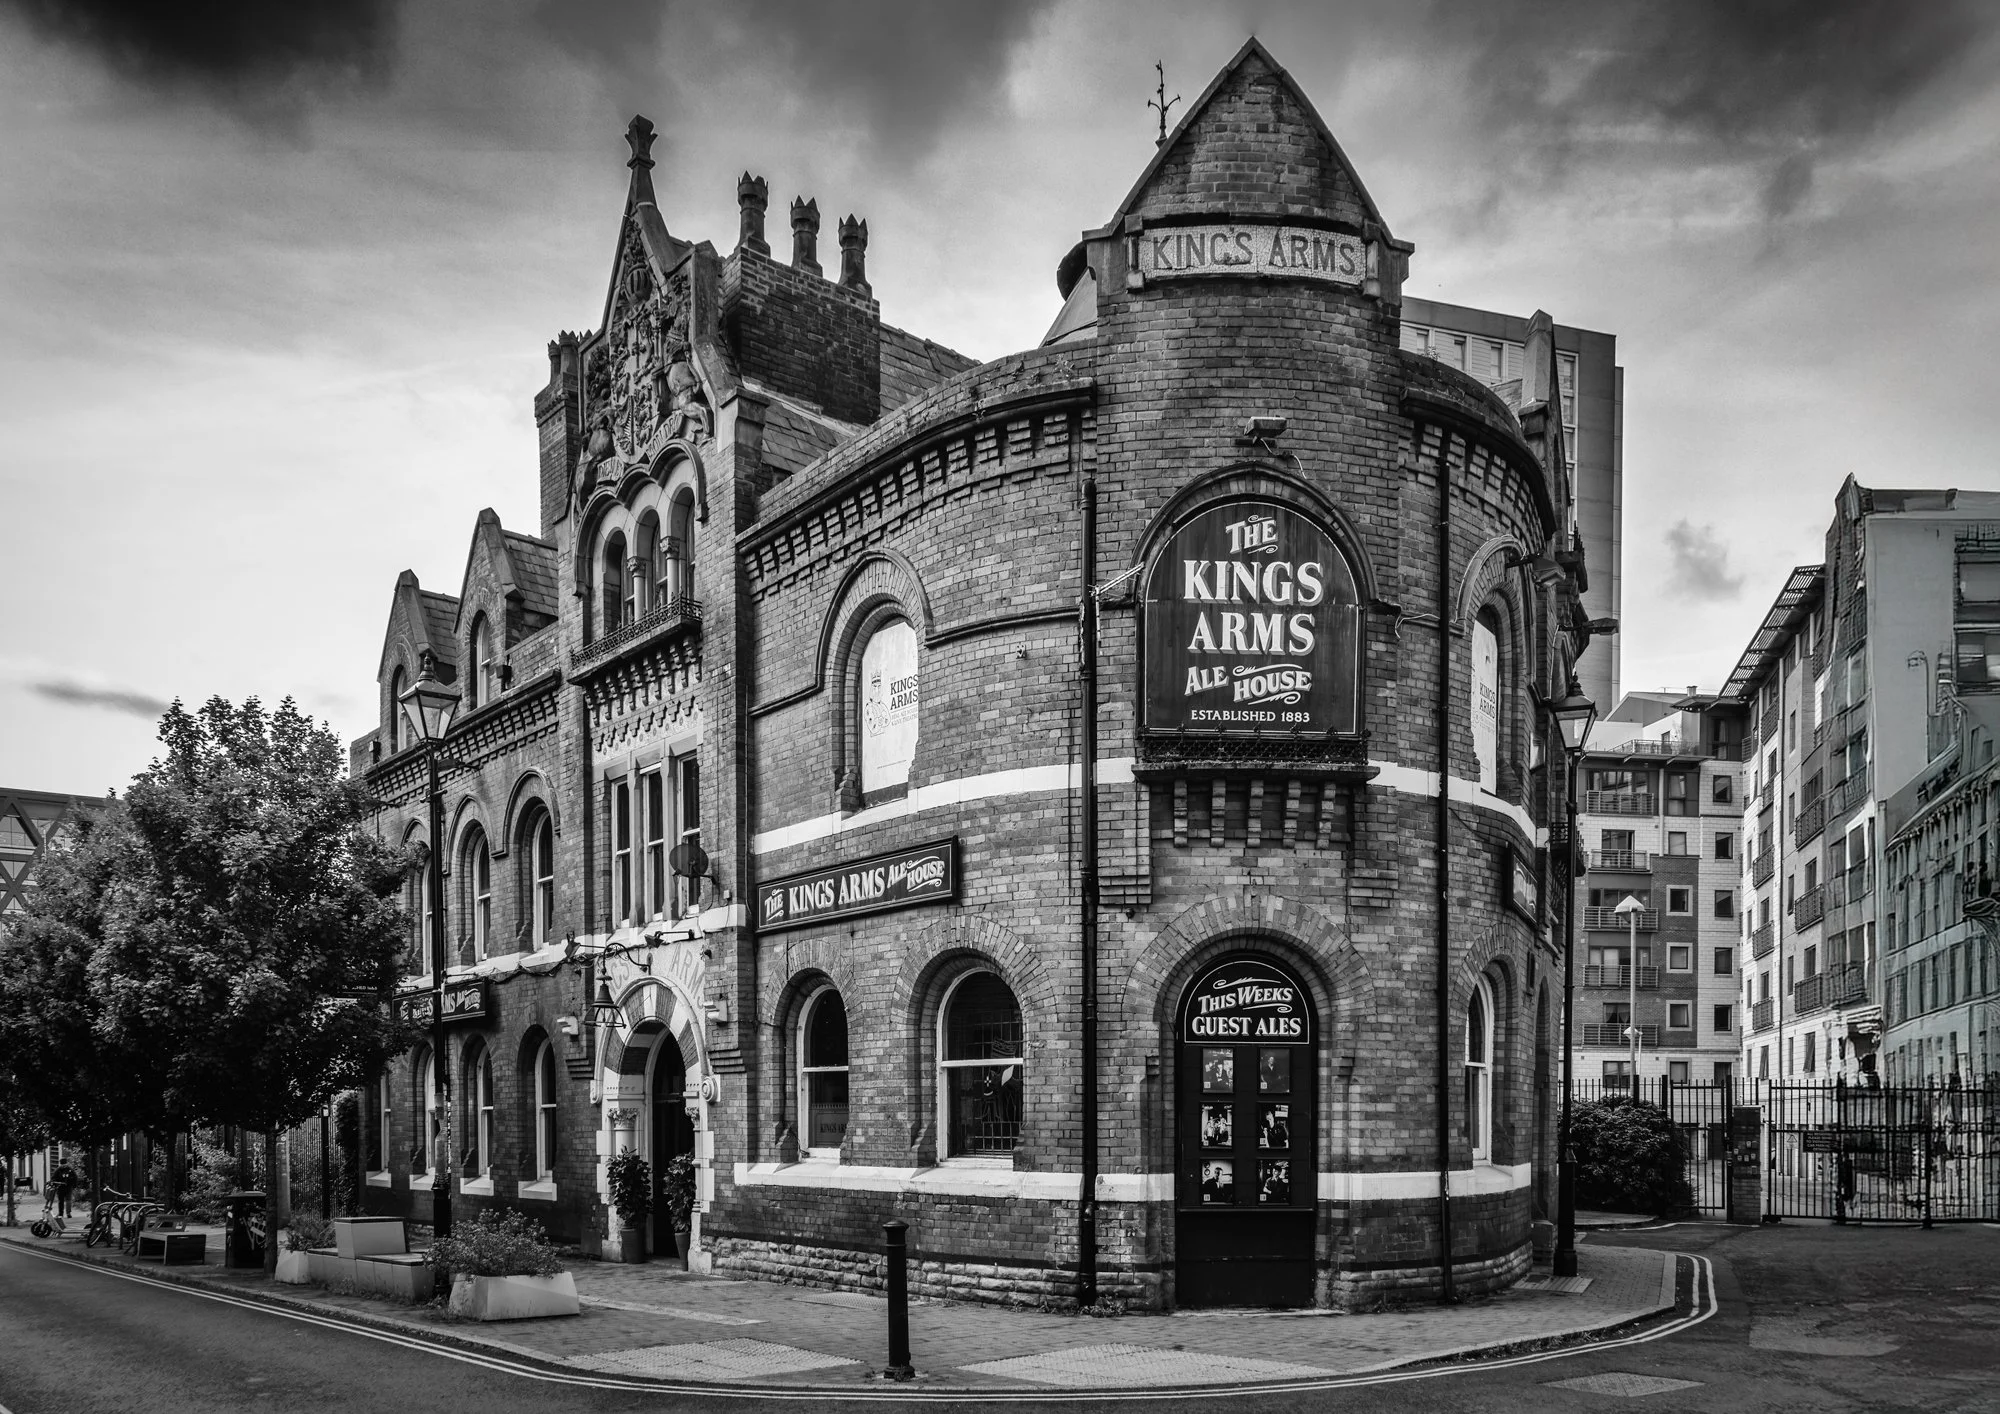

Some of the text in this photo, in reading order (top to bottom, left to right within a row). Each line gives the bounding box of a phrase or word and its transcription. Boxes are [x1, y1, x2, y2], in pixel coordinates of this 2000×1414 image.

[1269, 228, 1356, 275] ARMS
[1225, 519, 1278, 555] THE
[1183, 560, 1324, 606] KINGS
[1187, 611, 1315, 656] ARMS
[890, 674, 918, 695] KINGS
[890, 689, 918, 710] ARMS
[1184, 665, 1312, 702] ALE HOUSE
[1191, 709, 1310, 722] ESTABLISHED 1883
[764, 860, 945, 918] THE KINGS ARMS ALE HOUSE
[1198, 985, 1294, 1015] THIS WEEKS
[1191, 1016, 1302, 1037] GUEST ALES
